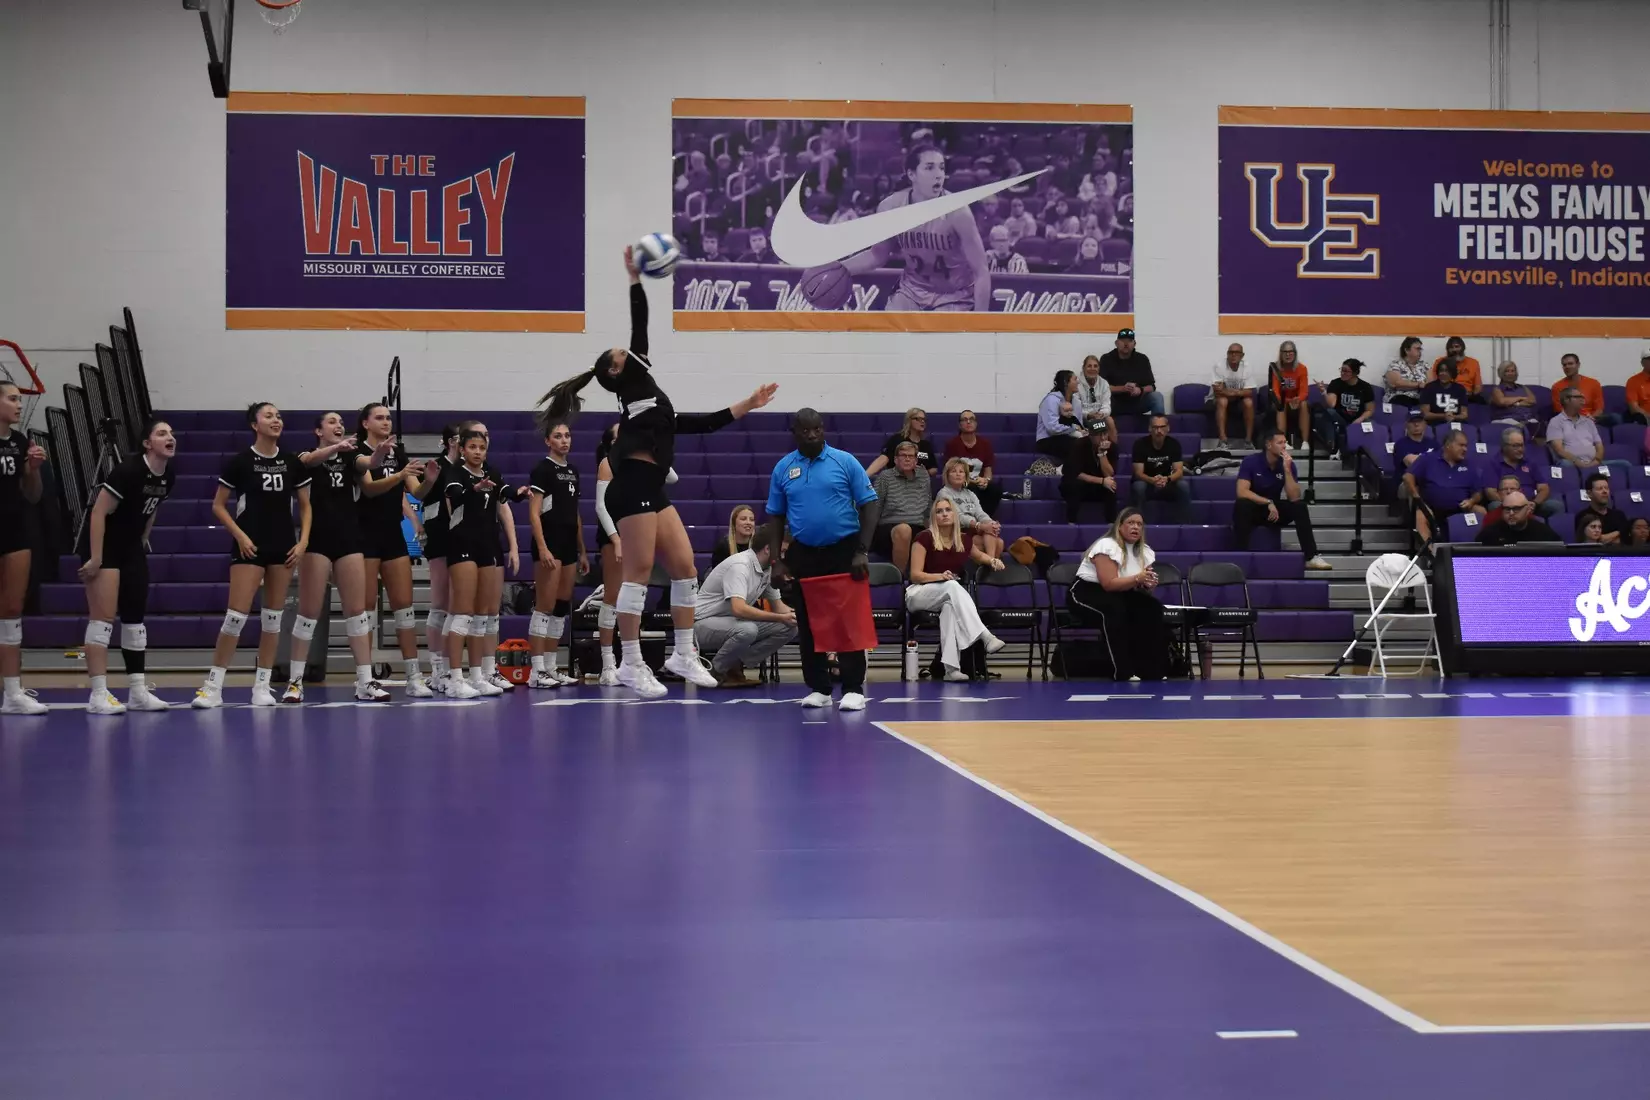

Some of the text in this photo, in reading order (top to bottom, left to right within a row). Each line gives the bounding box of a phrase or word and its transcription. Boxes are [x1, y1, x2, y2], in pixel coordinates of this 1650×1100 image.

[371, 154, 436, 176] THE
[1483, 159, 1614, 178] Welcome to
[297, 149, 515, 257] VALLEY
[1433, 183, 1539, 219] MEEKS
[1244, 162, 1380, 279] UE
[1458, 225, 1645, 262] FIELDHOUSE
[303, 263, 505, 277] MISSOURI VALLEY CONFERENCE
[1445, 267, 1564, 288] Evansville,
[1341, 393, 1361, 412] UE
[1436, 393, 1458, 413] UE
[1092, 421, 1106, 430] SIU
[0, 456, 16, 475] 13
[262, 473, 283, 492] 20
[329, 472, 344, 488] 12
[142, 497, 159, 515] 18
[1568, 558, 1650, 642] Ac
[512, 669, 522, 680] G
